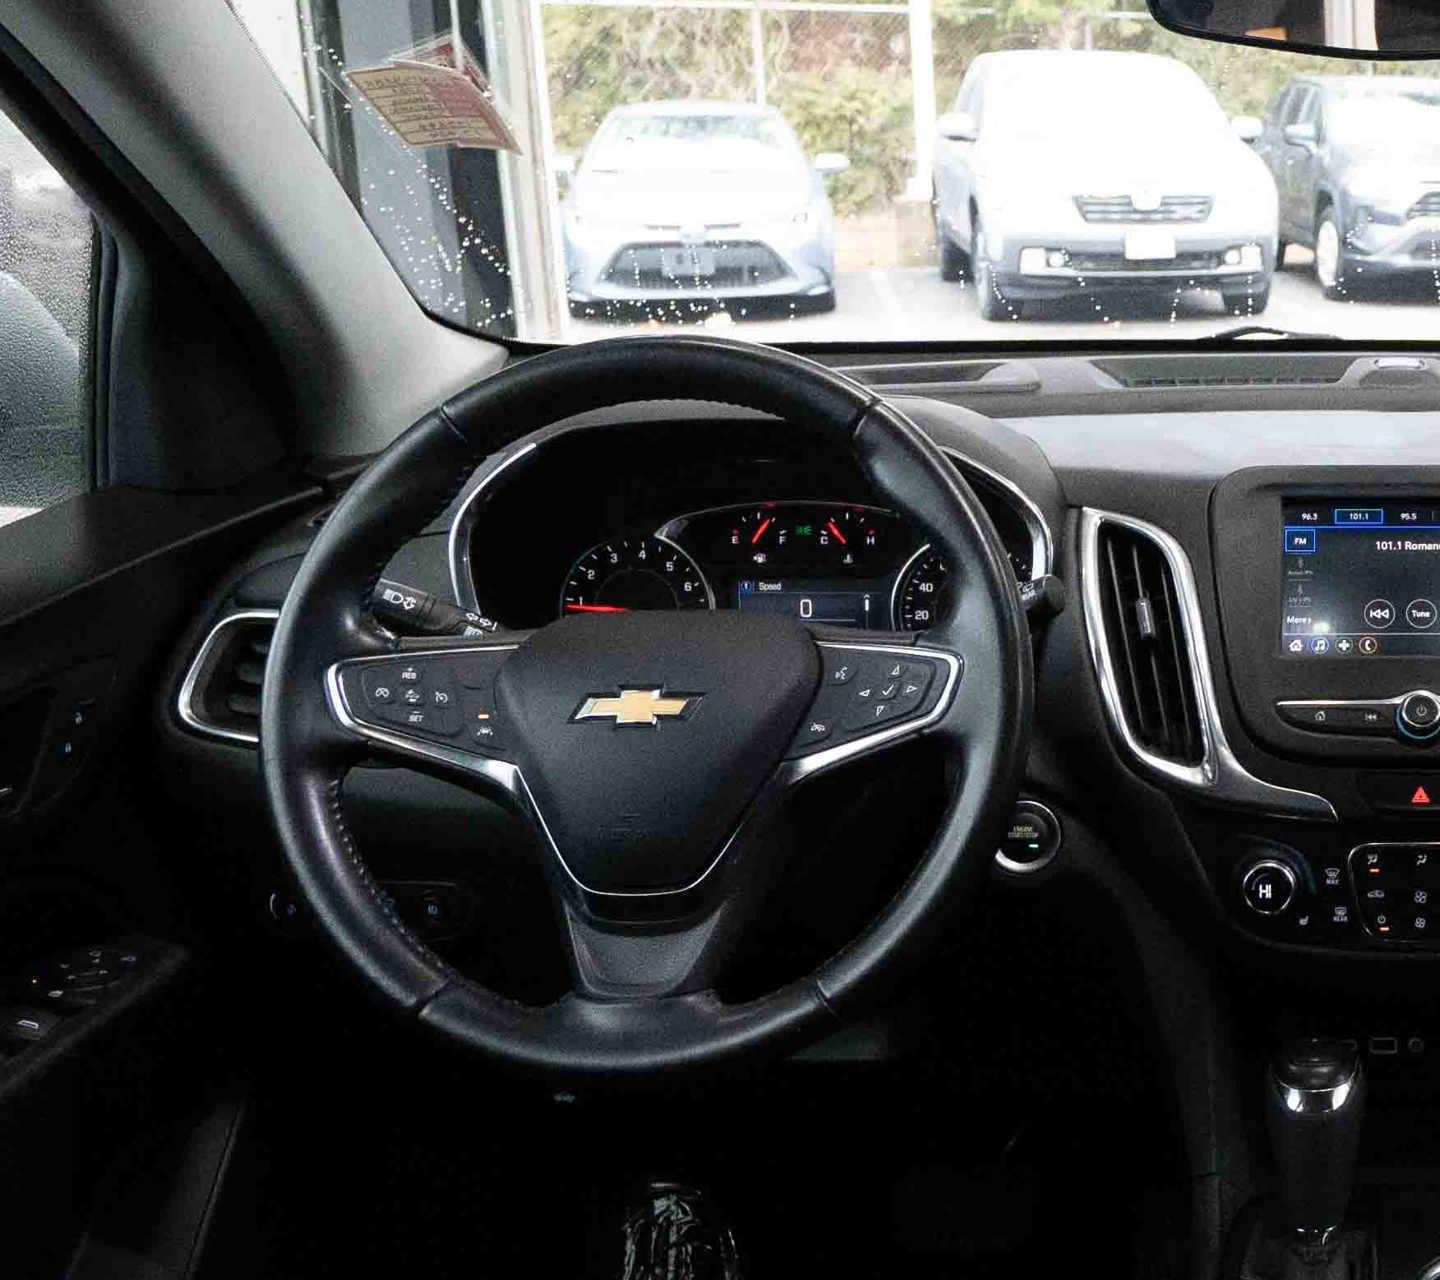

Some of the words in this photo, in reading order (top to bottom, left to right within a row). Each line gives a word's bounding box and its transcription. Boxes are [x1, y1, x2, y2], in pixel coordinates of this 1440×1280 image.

[731, 536, 739, 544] E
[779, 536, 787, 544] F
[820, 536, 829, 545] C
[866, 536, 875, 545] H
[1294, 537, 1307, 545] FM
[1375, 540, 1402, 551] 101.1
[610, 552, 619, 564] 3
[638, 550, 646, 560] 4
[665, 561, 674, 572] 5
[587, 569, 595, 580] 2
[684, 581, 692, 592] 6
[758, 581, 782, 592] Speed
[919, 582, 934, 593] 40
[799, 598, 813, 618] 0
[1411, 609, 1431, 618] Tune
[914, 609, 929, 621] 20
[1257, 884, 1272, 900] HI
